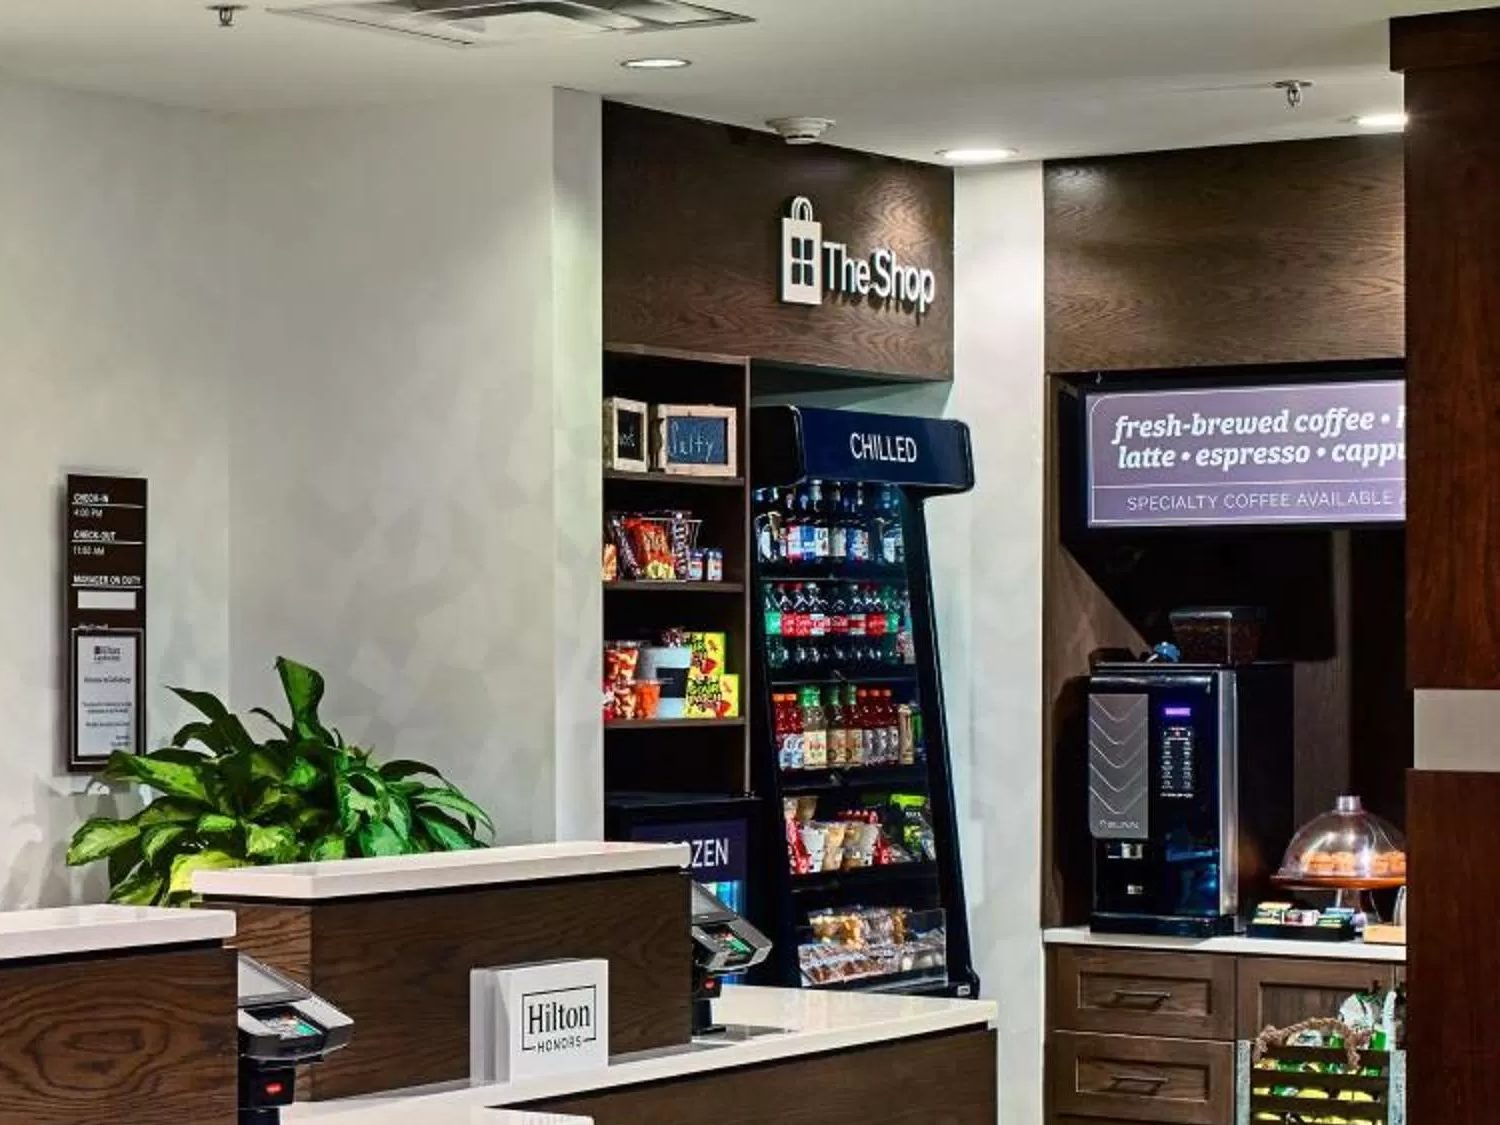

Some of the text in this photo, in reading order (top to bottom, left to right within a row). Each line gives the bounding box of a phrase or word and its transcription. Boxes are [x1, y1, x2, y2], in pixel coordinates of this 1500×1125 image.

[822, 241, 935, 313] The Shop
[1110, 409, 1290, 445] fresh-brewed
[1294, 407, 1376, 439] coffee
[849, 432, 918, 463] CHILLED
[1118, 445, 1177, 469] latte
[1195, 445, 1311, 472] espresso
[1126, 494, 1219, 511] SPECIALTY
[1223, 492, 1292, 509] COFFEE
[1295, 489, 1394, 508] AVAILABLE
[691, 838, 729, 868] ZEN
[528, 1001, 592, 1035] Hilton
[536, 1035, 583, 1054] HONORS
